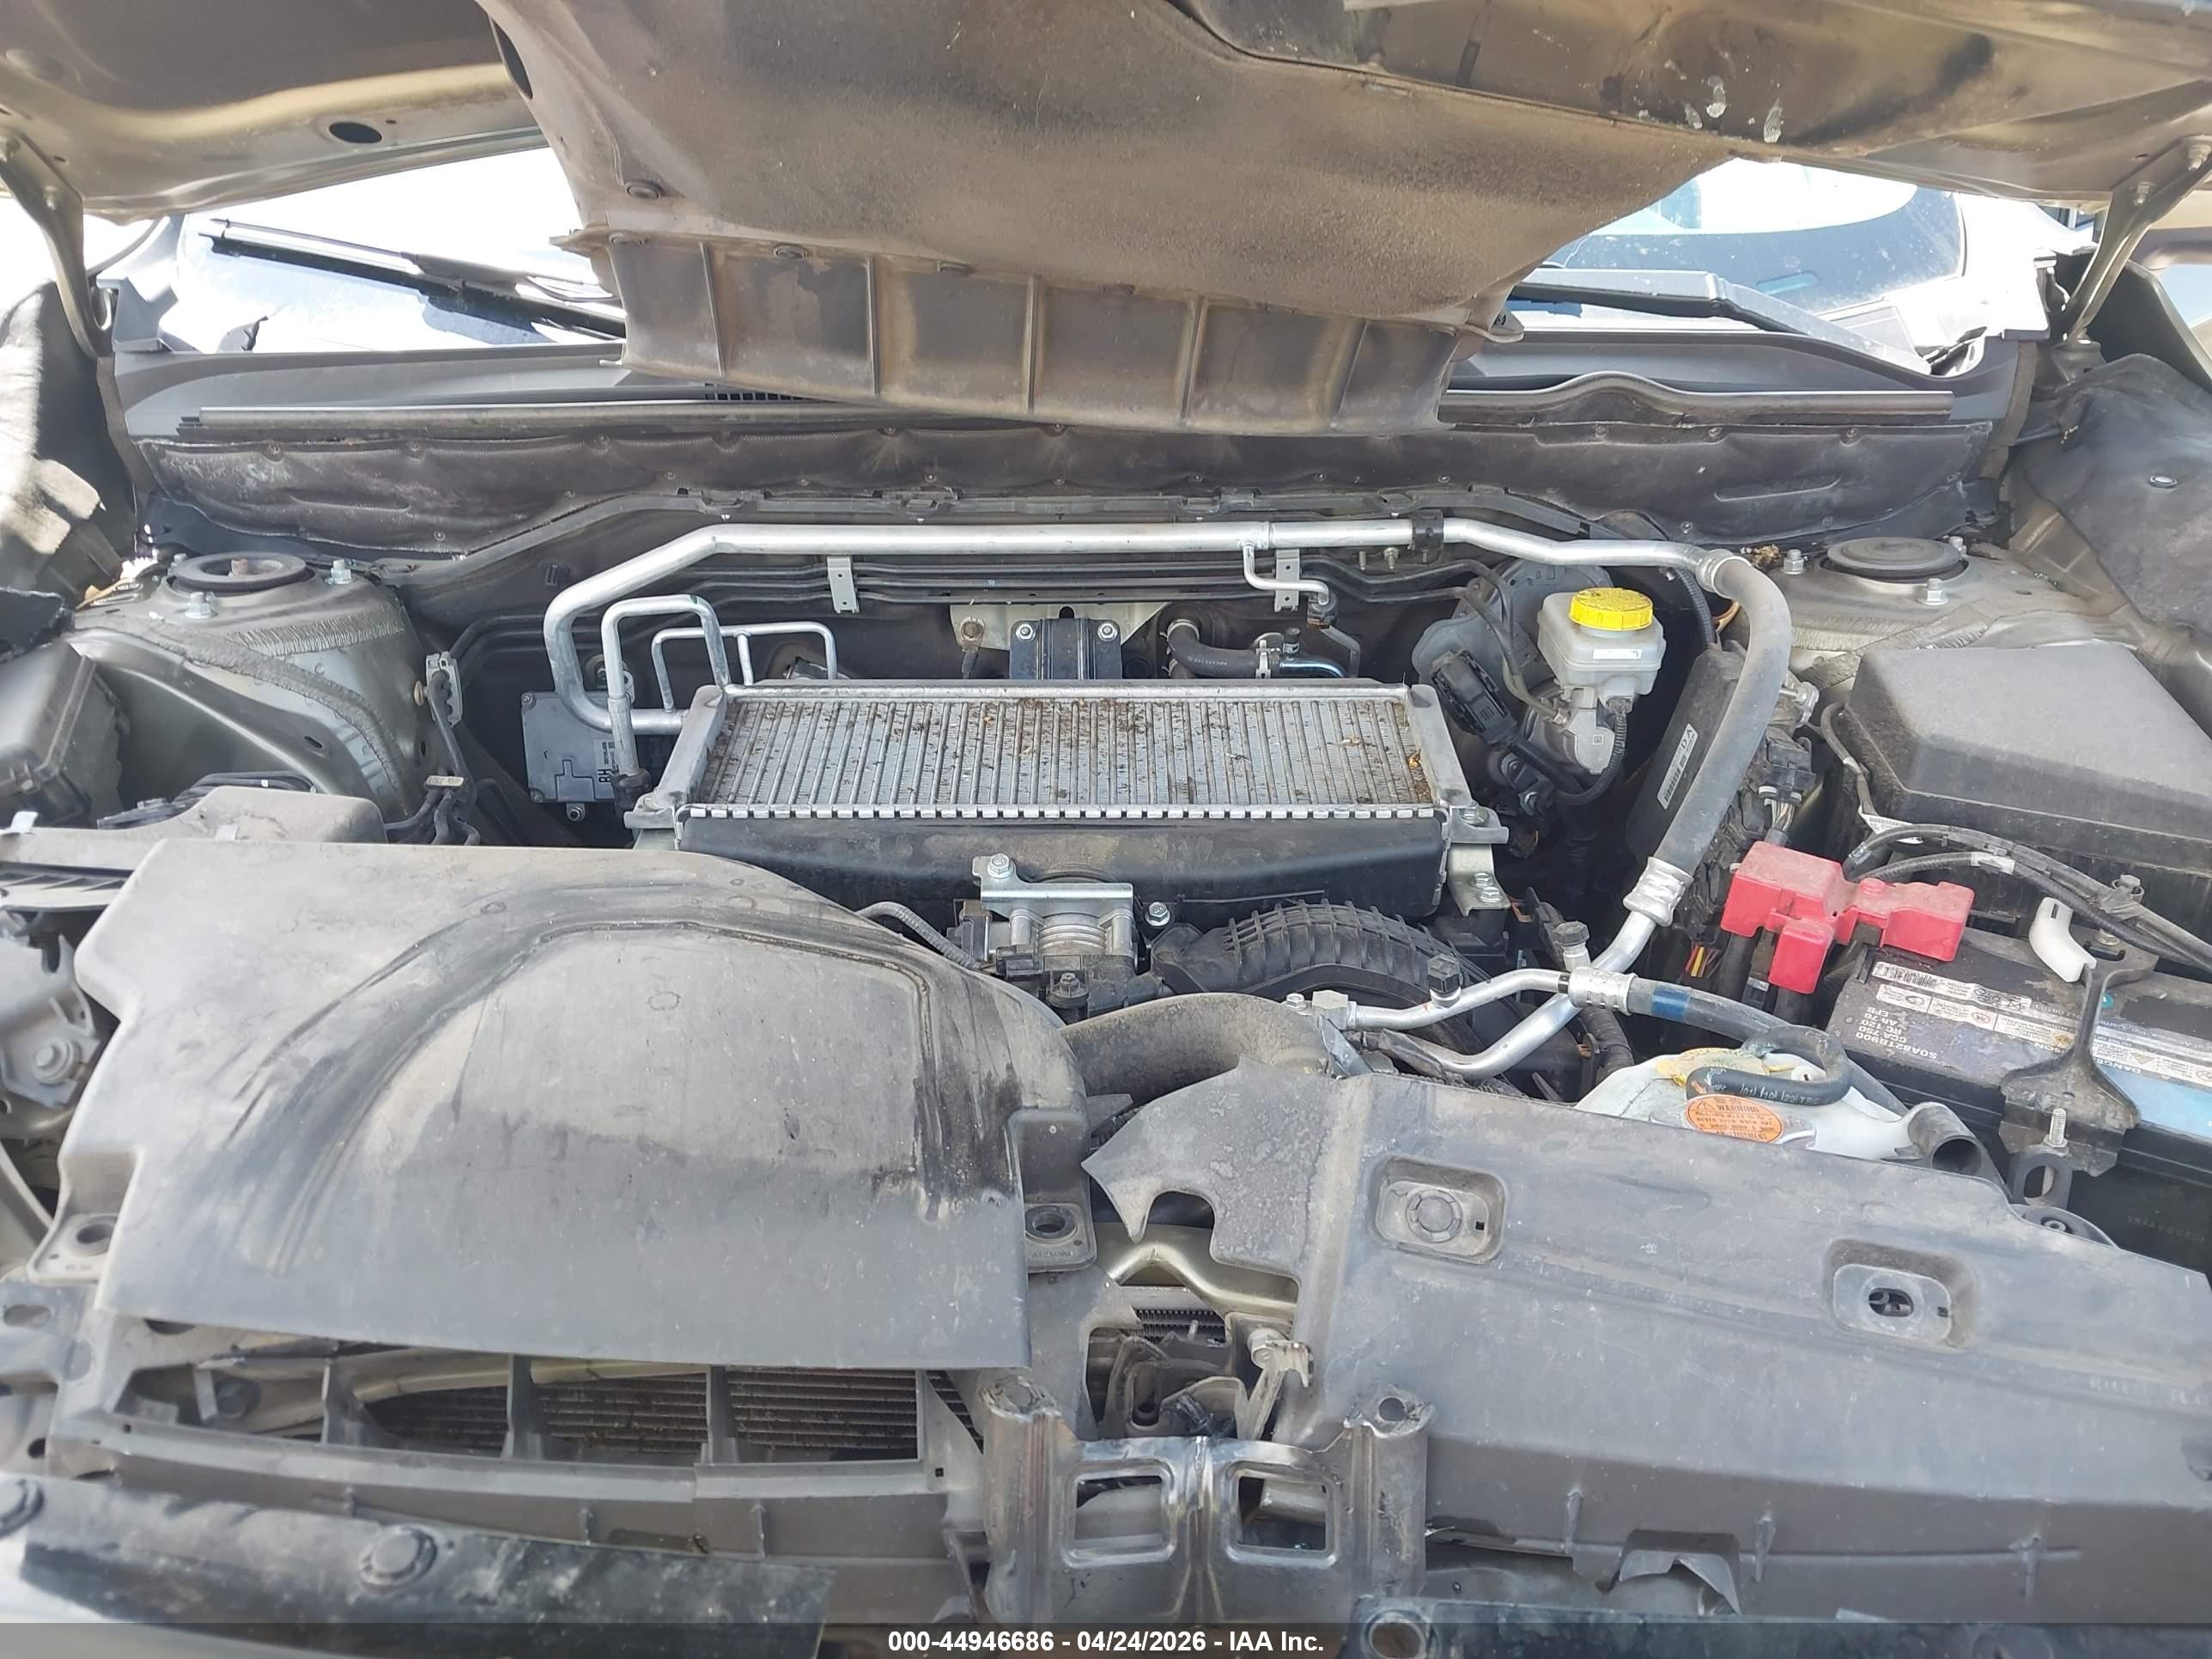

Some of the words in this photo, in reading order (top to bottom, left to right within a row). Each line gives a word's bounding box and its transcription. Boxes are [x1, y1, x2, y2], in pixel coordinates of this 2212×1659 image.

[1867, 1006, 1889, 1018] EFB
[1861, 1019, 1881, 1030] 120
[1881, 1018, 1898, 1026] Ah
[1858, 1025, 1880, 1036] 750
[1886, 1026, 1903, 1036] RC
[1883, 1032, 1907, 1043] CCA
